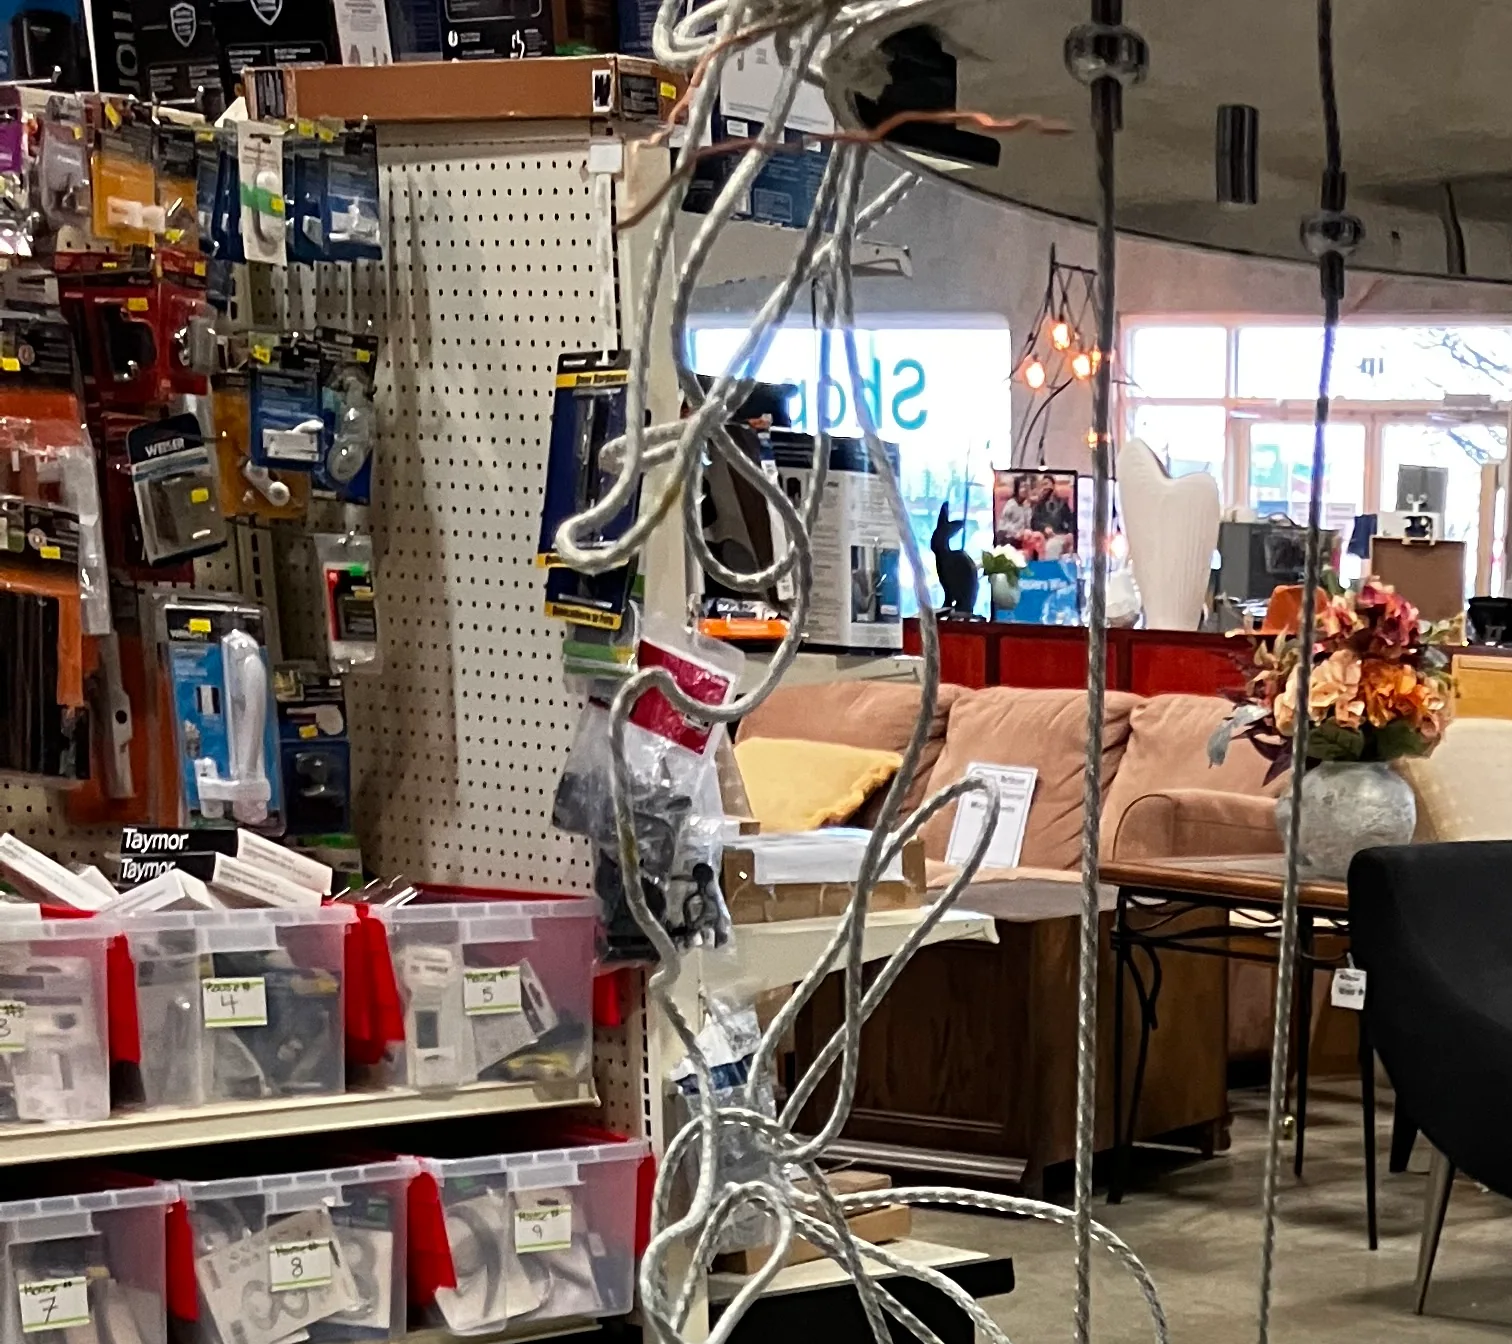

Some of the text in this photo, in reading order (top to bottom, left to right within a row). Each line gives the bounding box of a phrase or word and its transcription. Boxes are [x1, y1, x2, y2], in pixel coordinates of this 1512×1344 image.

[122, 827, 189, 854] Taymor
[121, 858, 176, 883] Taymor
[220, 992, 239, 1016] 4
[482, 986, 494, 1004] 5
[532, 1224, 543, 1241] 9
[290, 1257, 304, 1278] 8
[38, 1296, 59, 1325] 7
